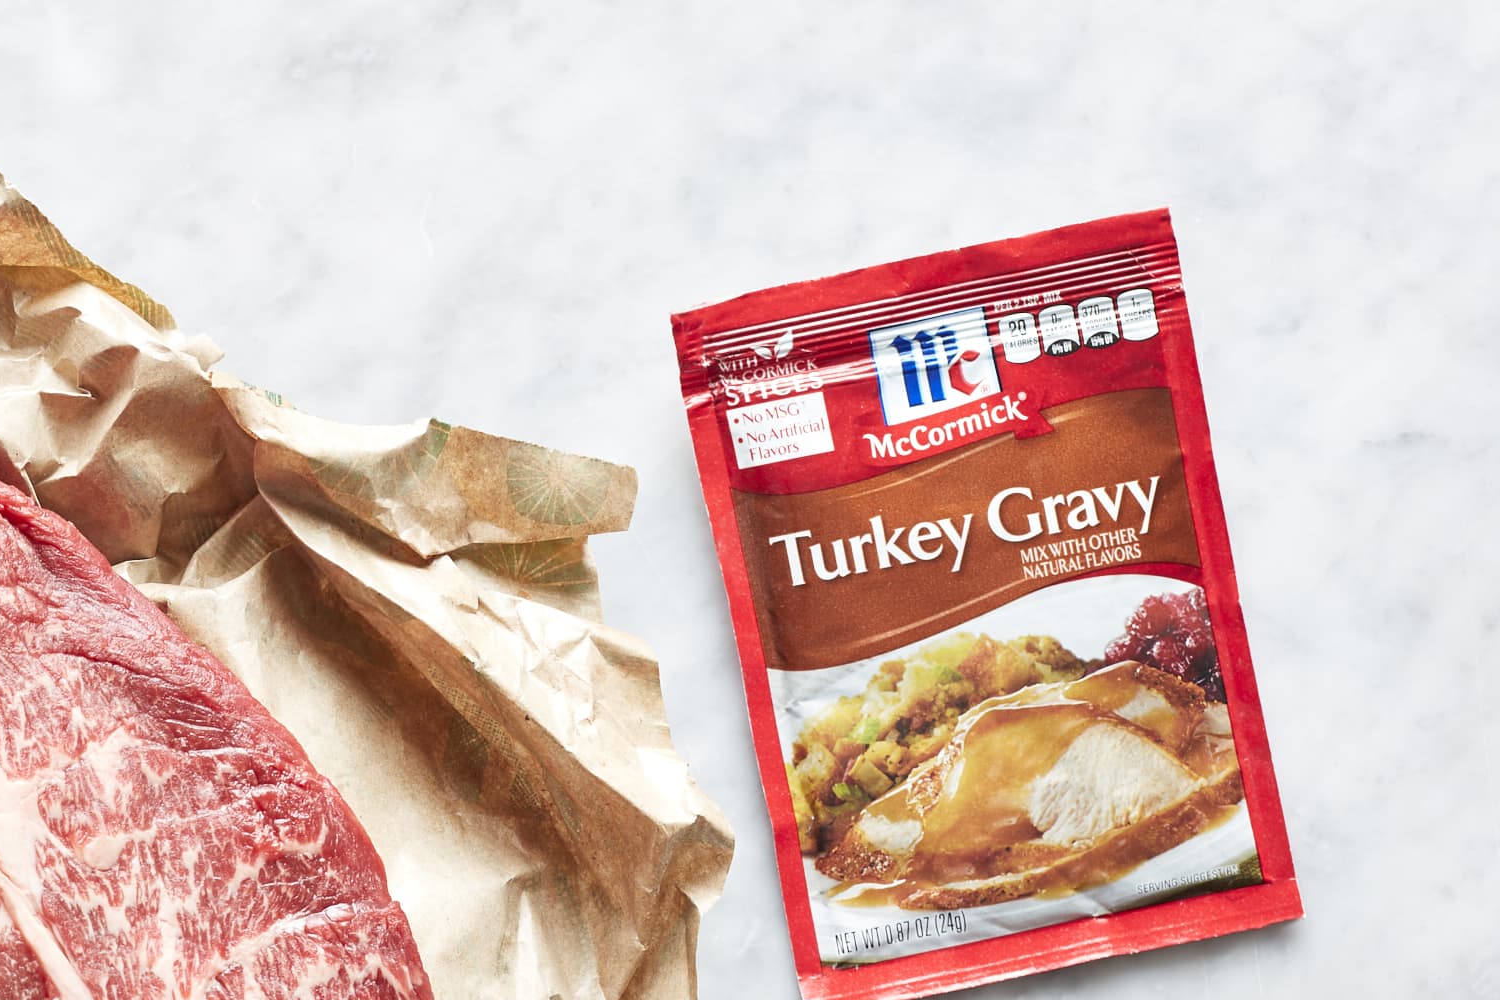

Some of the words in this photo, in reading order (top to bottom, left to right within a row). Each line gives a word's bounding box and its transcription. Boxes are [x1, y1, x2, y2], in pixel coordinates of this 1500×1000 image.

[1008, 319, 1027, 338] 20
[718, 355, 758, 373] WITH
[724, 371, 825, 407] SPICES
[741, 411, 763, 425] No
[745, 431, 767, 445] No
[769, 417, 826, 442] Artificial
[863, 394, 1029, 460] McCormick
[748, 442, 800, 462] Flavors
[768, 513, 974, 587] Turkey
[987, 475, 1161, 543] Gravy
[1020, 545, 1050, 565] MIX
[1048, 537, 1088, 558] WITH
[1088, 527, 1139, 551] OTHER
[1022, 555, 1085, 580] NATURAL
[1084, 543, 1142, 569] FLAVORS
[1136, 878, 1179, 895] SERVING
[834, 929, 859, 956] NET
[861, 925, 882, 950] WT
[884, 920, 911, 945] 0.87
[914, 916, 932, 939] OZ
[934, 910, 968, 937] (24g)
